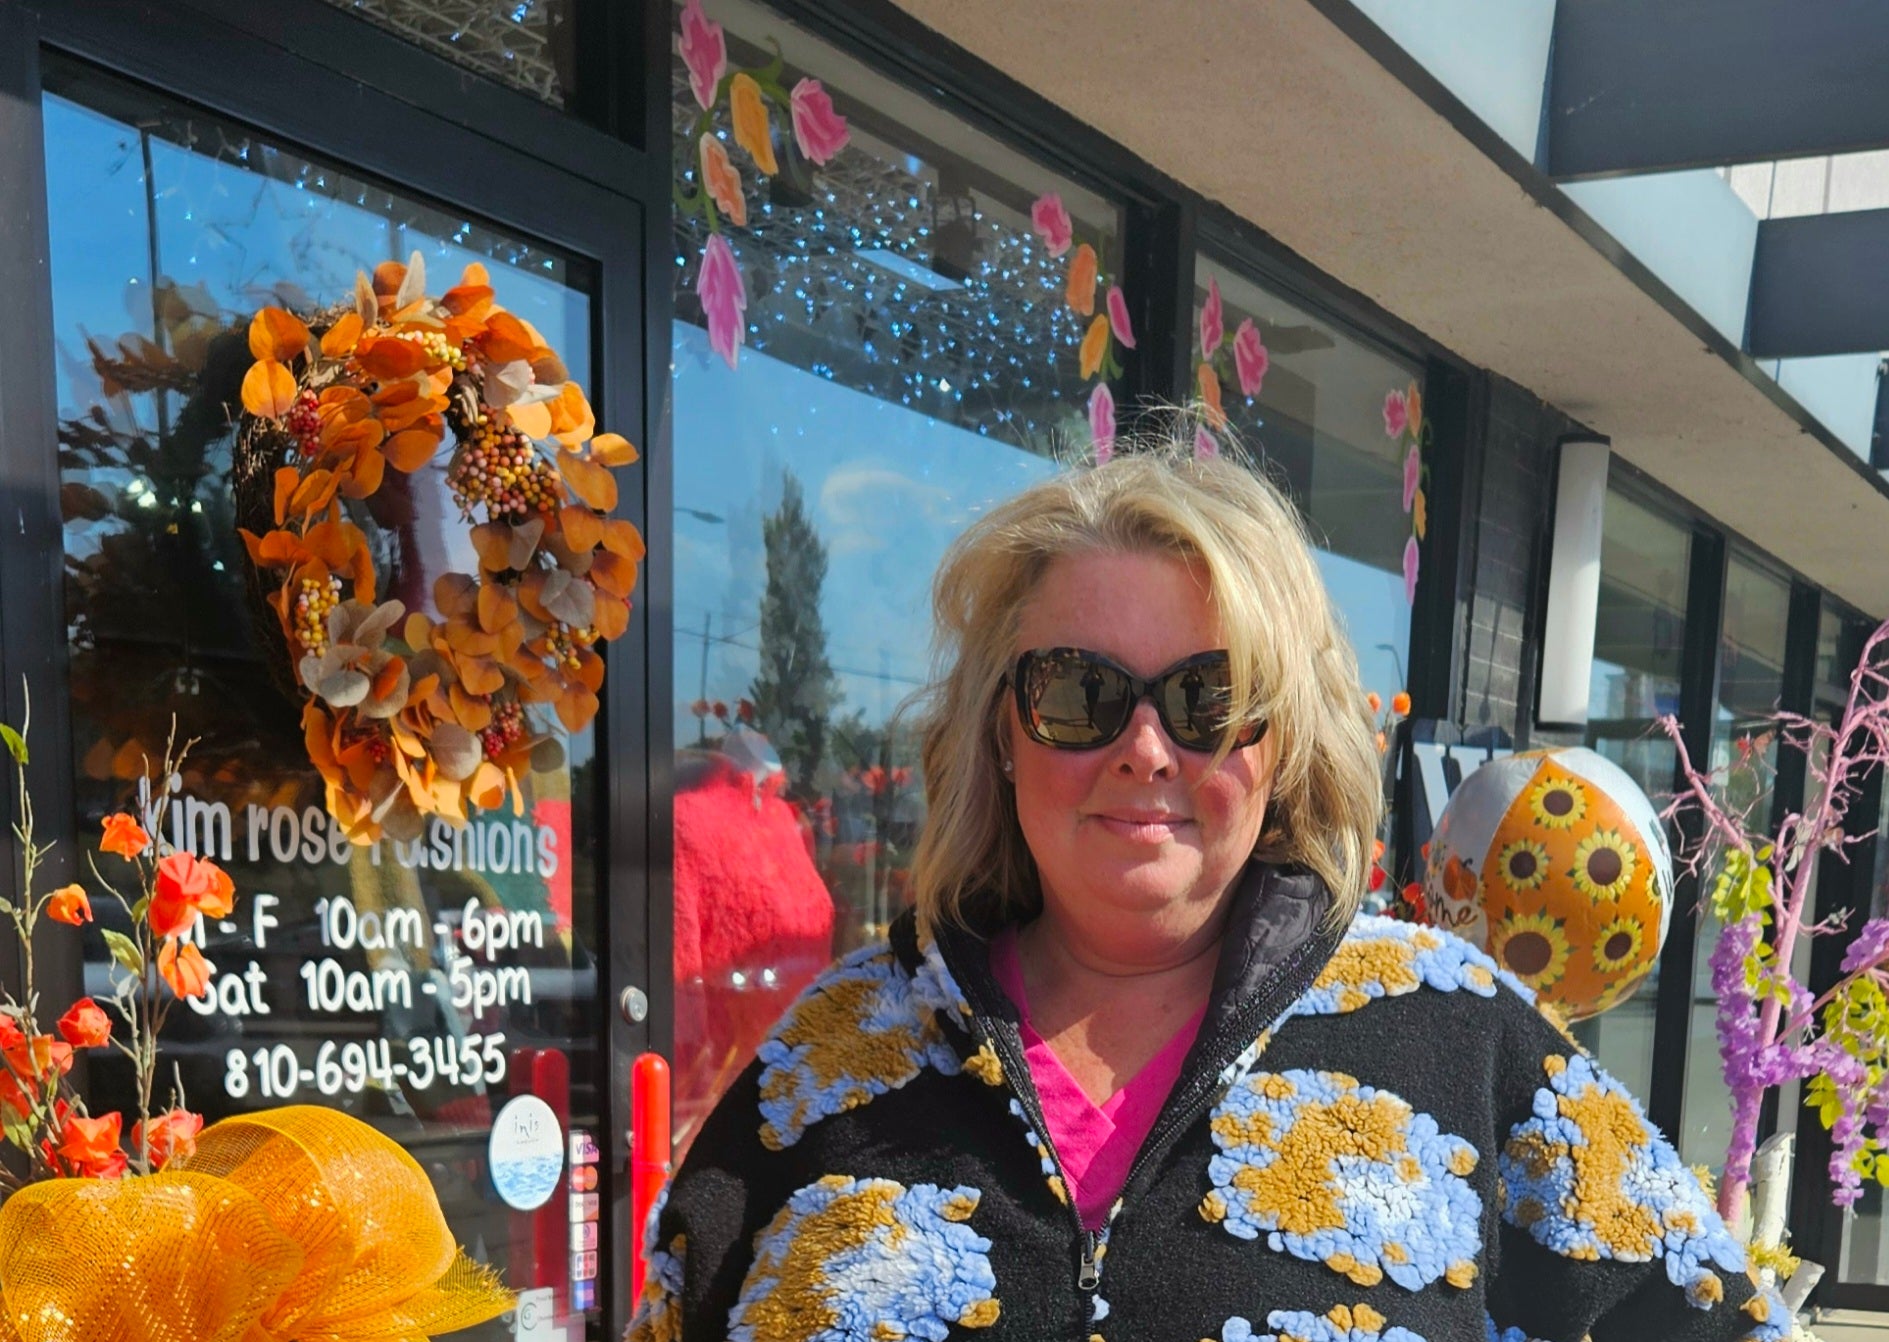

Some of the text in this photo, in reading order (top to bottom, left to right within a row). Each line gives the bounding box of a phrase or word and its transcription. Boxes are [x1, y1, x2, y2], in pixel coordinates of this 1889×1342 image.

[248, 803, 352, 865] rose
[370, 807, 558, 878] ashions
[253, 894, 279, 949] F
[314, 895, 424, 949] 10am
[461, 896, 543, 962] 6pm
[186, 957, 271, 1016] Sat
[300, 957, 413, 1012] 10am
[449, 955, 532, 1020] 5pm
[224, 1032, 506, 1098] 810-694-3455
